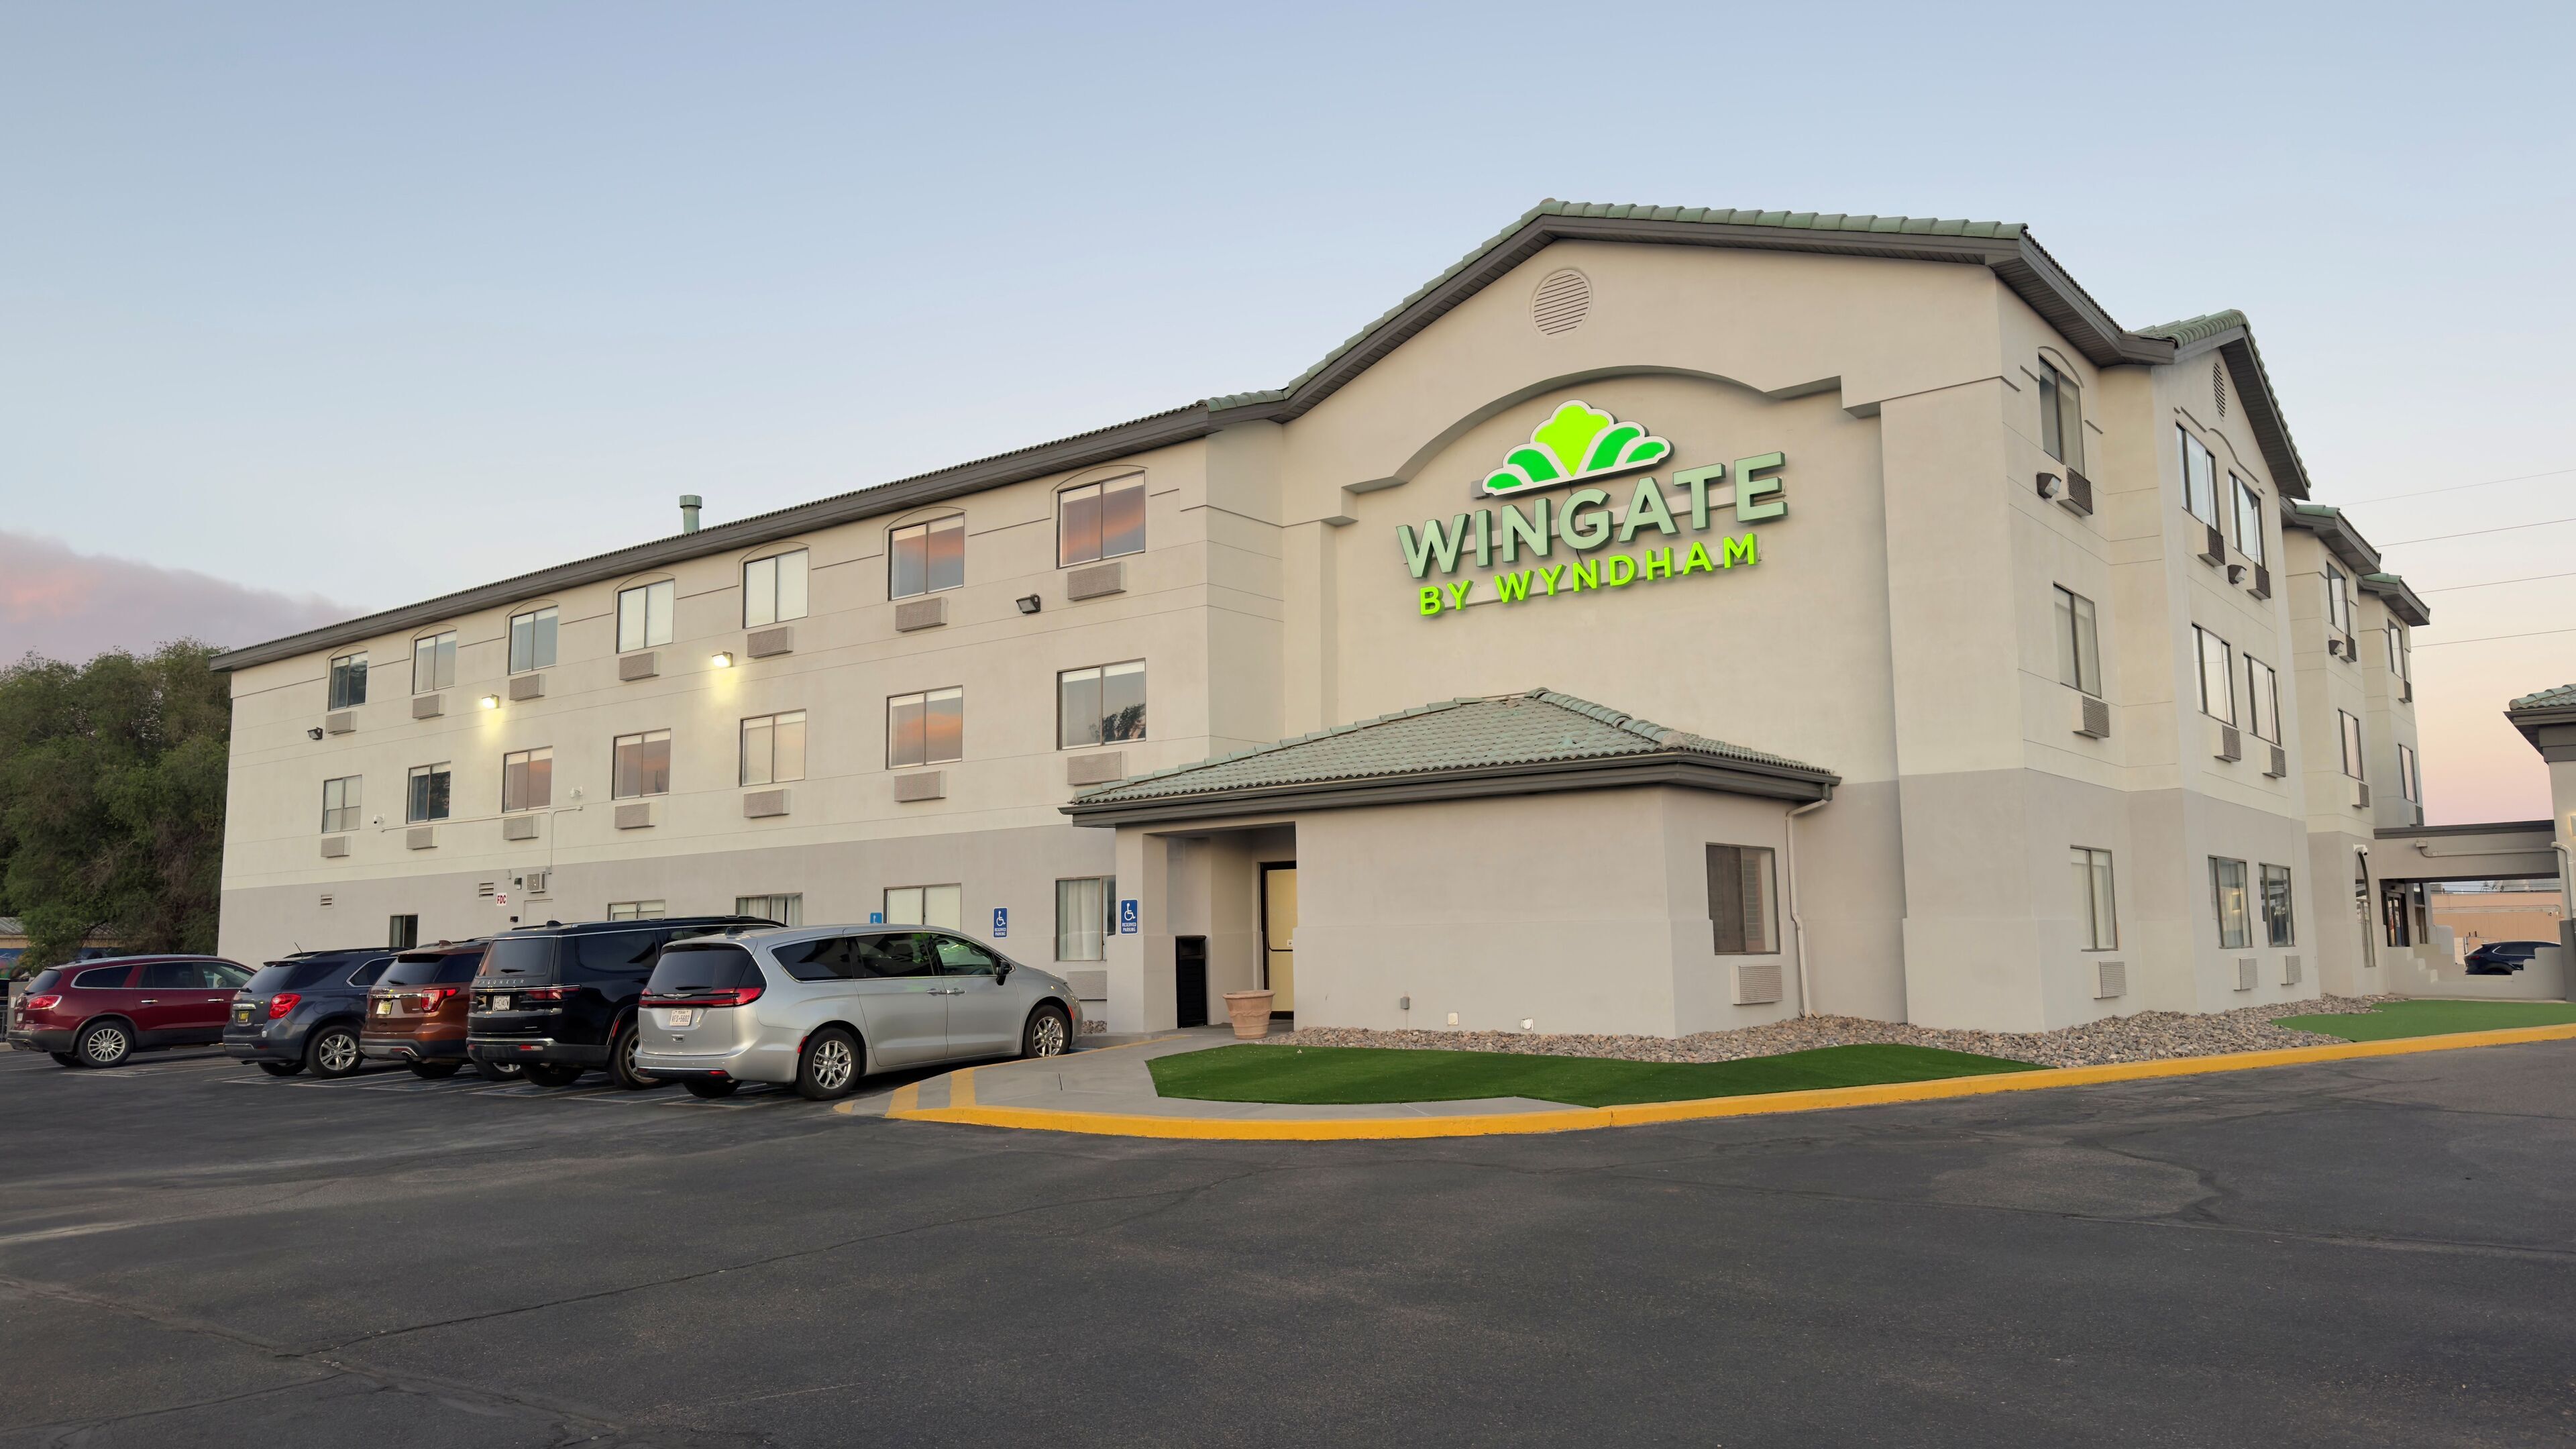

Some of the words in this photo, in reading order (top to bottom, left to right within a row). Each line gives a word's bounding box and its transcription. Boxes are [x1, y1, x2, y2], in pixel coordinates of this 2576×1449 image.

[1396, 451, 1788, 580] WINGATE
[1419, 580, 1474, 617] BY
[1495, 533, 1759, 604] WYNDHAM
[496, 895, 506, 904] FDC
